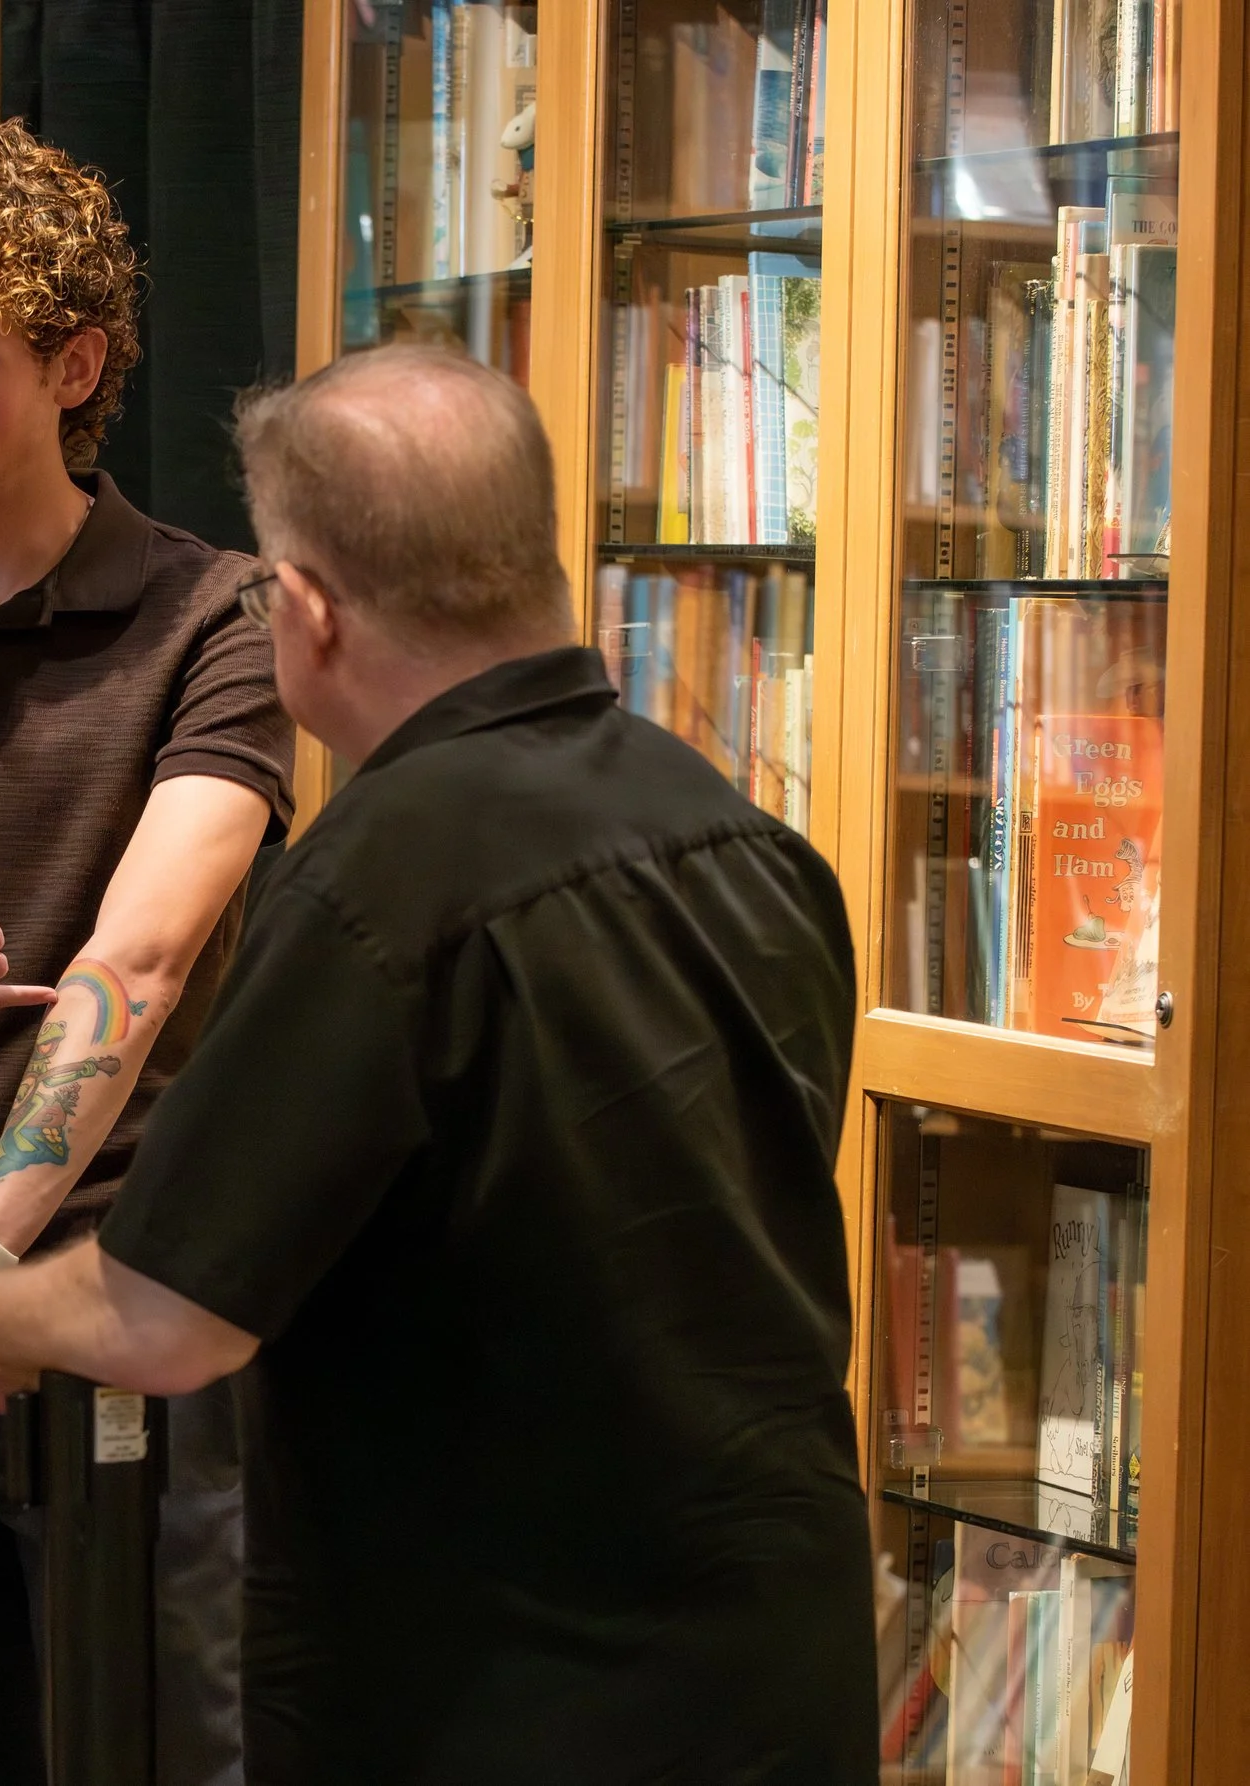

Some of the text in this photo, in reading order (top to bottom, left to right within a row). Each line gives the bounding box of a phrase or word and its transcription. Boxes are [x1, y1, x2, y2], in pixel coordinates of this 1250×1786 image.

[1131, 220, 1154, 235] THE
[1053, 734, 1131, 760] Green
[1075, 770, 1142, 807] Eggs
[1053, 817, 1105, 840] and
[1054, 854, 1114, 878] Ham
[1072, 991, 1094, 1011] By
[1053, 1218, 1094, 1261] Runny
[1075, 1436, 1089, 1457] Shel
[1123, 1671, 1133, 1693] E
